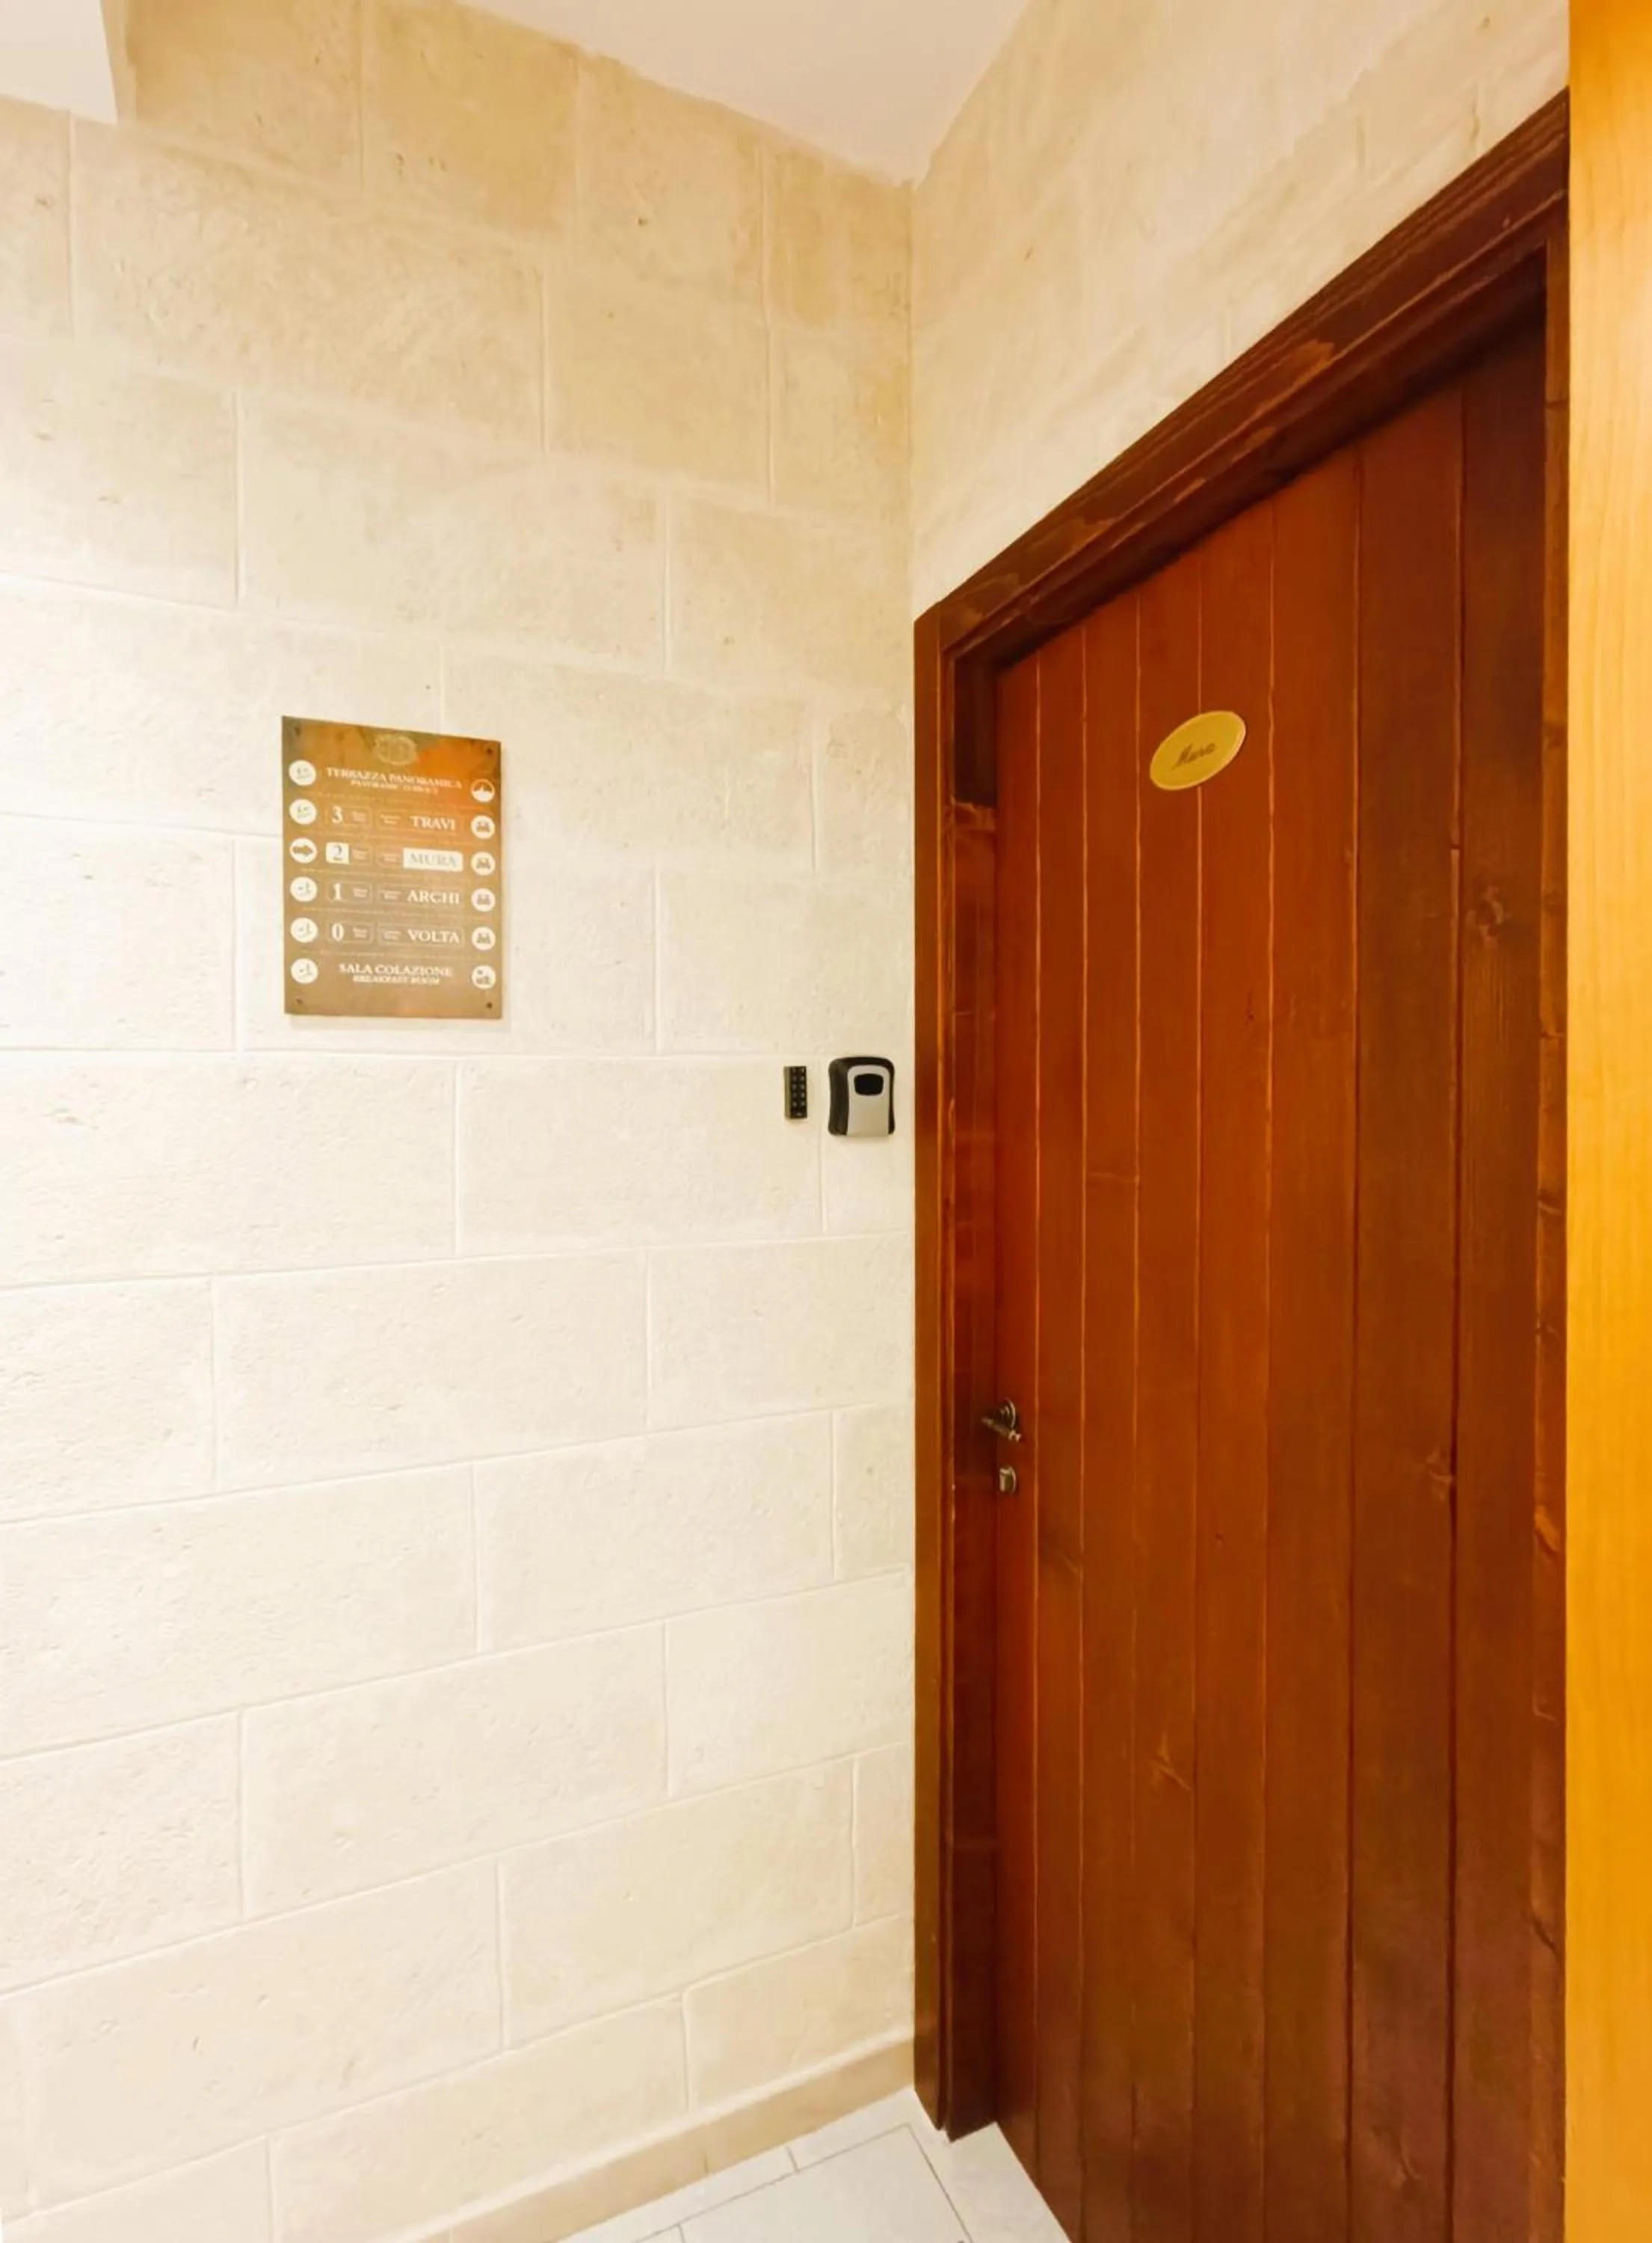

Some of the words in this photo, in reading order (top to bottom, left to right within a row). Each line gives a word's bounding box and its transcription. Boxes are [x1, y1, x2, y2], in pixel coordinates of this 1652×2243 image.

[326, 766, 387, 783] TERRAZZA
[389, 772, 463, 790] PANORAMICA
[331, 805, 344, 824] 3
[410, 815, 456, 831] TRAVI
[332, 844, 343, 861] 2
[410, 852, 457, 869] MURA
[333, 882, 342, 900] 1
[407, 889, 460, 905] ARCHI
[331, 923, 344, 942] 0
[407, 929, 460, 944] VOLTA
[339, 963, 372, 974] SALA
[375, 964, 454, 977] COLAZIONE
